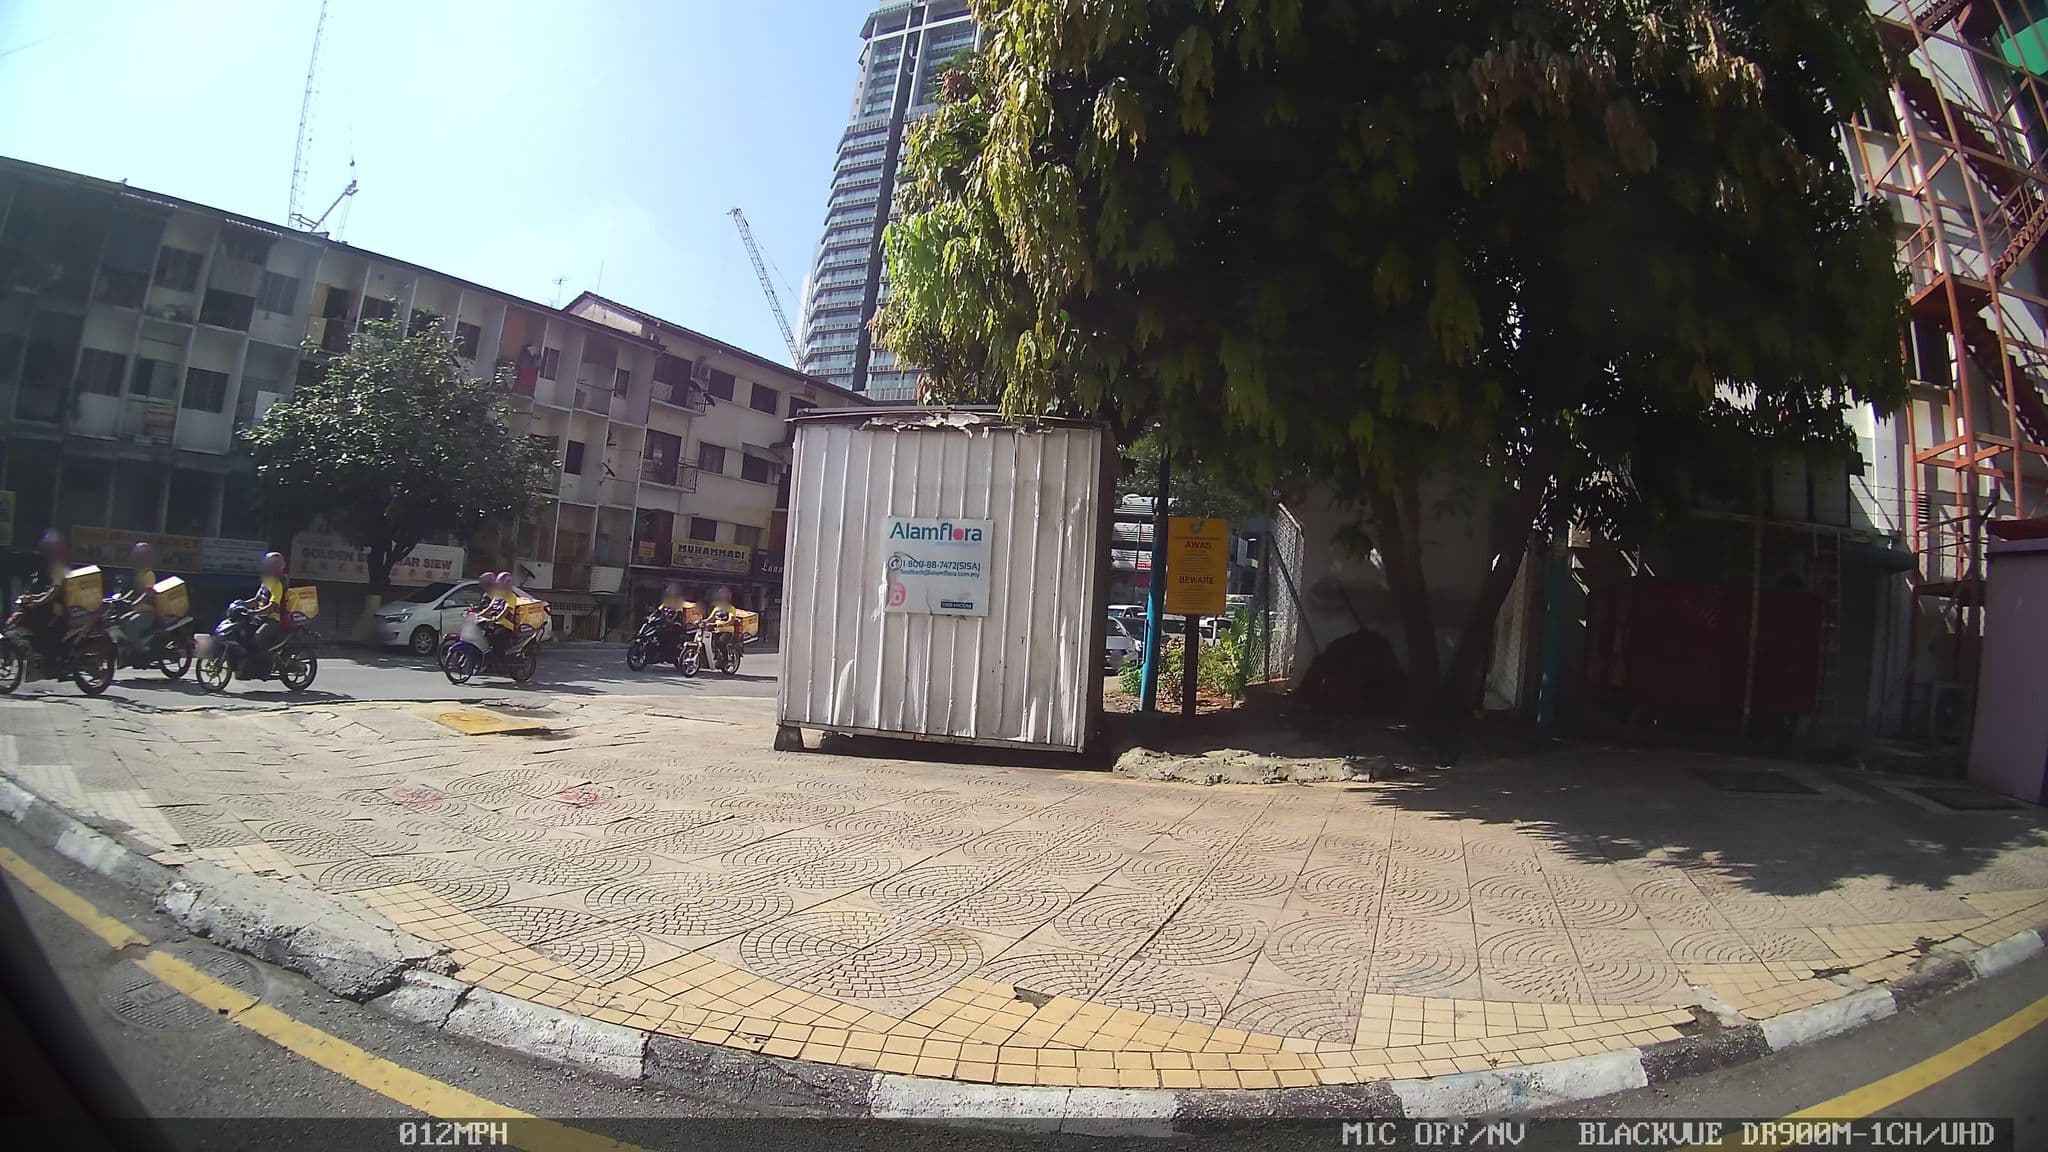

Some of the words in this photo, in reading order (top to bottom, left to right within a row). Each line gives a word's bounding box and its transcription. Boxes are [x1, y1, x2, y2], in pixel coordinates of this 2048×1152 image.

[889, 522, 982, 541] Alamflora
[678, 544, 745, 560] MUHAMMADI
[1184, 541, 1212, 550] AWAS
[303, 548, 354, 561] GOLDEN
[423, 558, 453, 570] SIEW
[1178, 576, 1216, 585] BEWARE
